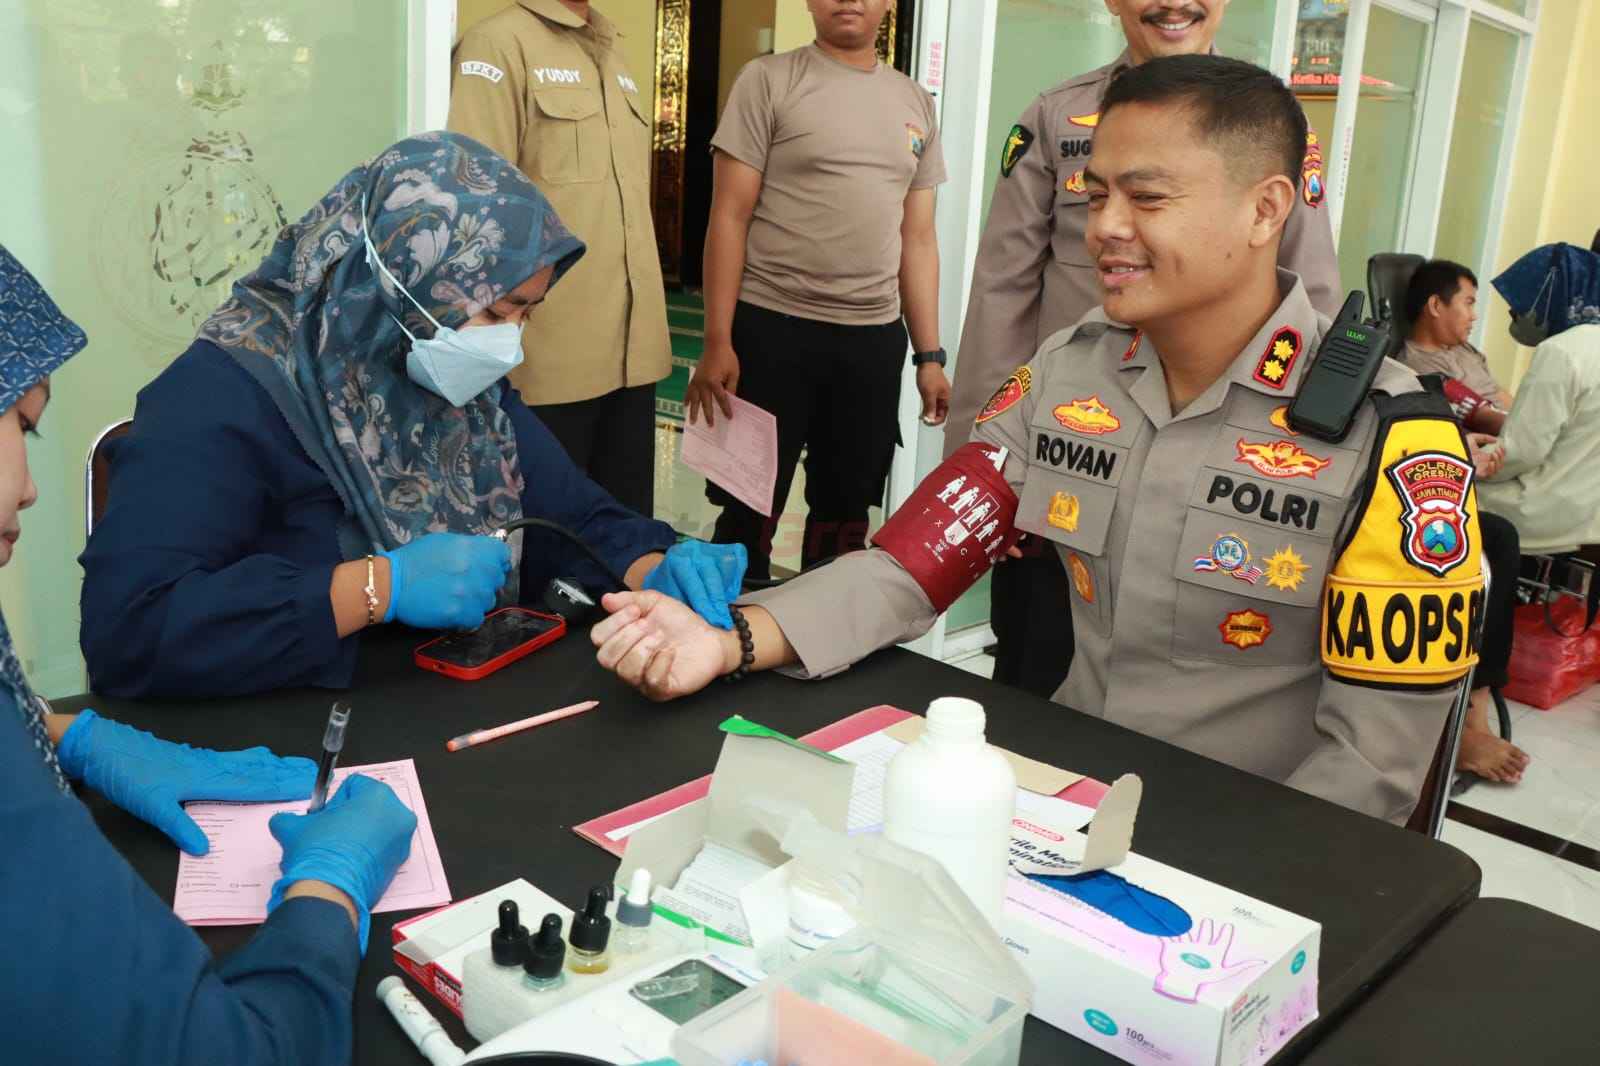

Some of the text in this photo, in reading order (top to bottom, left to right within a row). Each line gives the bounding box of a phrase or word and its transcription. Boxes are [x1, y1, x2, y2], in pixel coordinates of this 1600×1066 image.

[533, 67, 582, 84] YUDDY
[1036, 433, 1117, 481] ROVAN
[1404, 461, 1464, 479] POLRES
[1414, 470, 1457, 481] GRESIK
[1416, 487, 1459, 500] JAWA TIMUR
[1206, 475, 1320, 531] POLRI
[1326, 587, 1375, 661] KA
